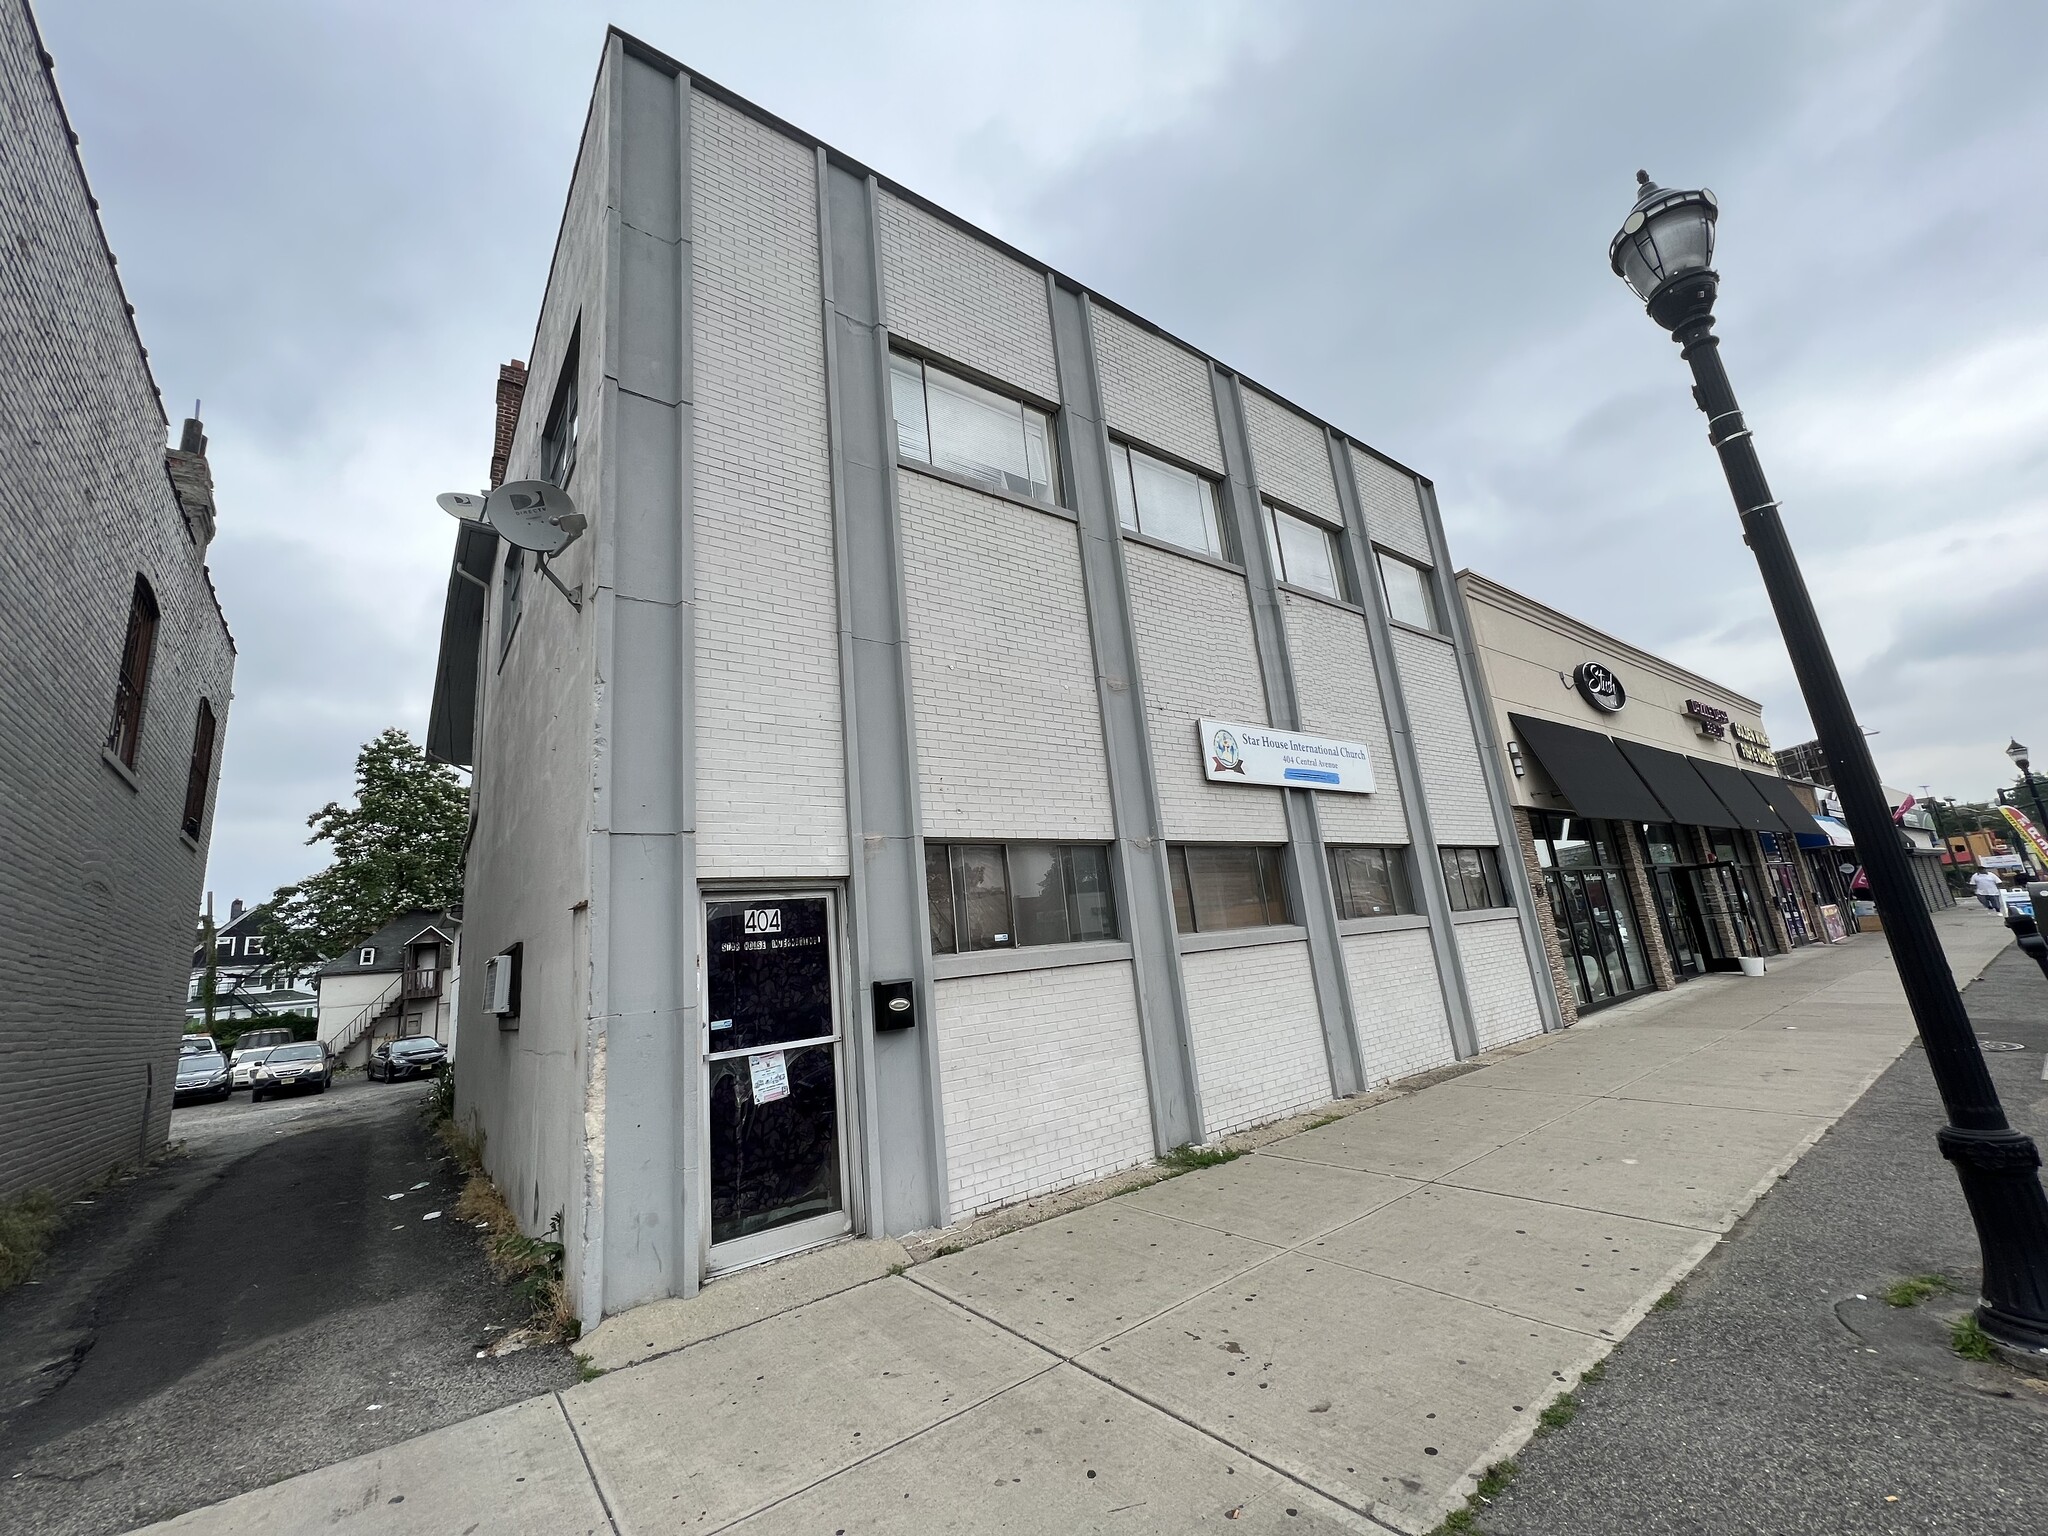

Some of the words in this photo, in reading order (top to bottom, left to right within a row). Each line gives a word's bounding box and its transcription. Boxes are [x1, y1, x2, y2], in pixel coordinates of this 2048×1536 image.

[515, 506, 547, 516] DIRECTV
[1242, 732, 1260, 747] Star
[1261, 735, 1289, 750] House
[1289, 739, 1340, 757] International
[1340, 746, 1367, 761] Church
[1283, 755, 1295, 765] 404
[1295, 756, 1318, 767] Central
[1318, 759, 1339, 769] Avenue
[745, 910, 780, 932] 404
